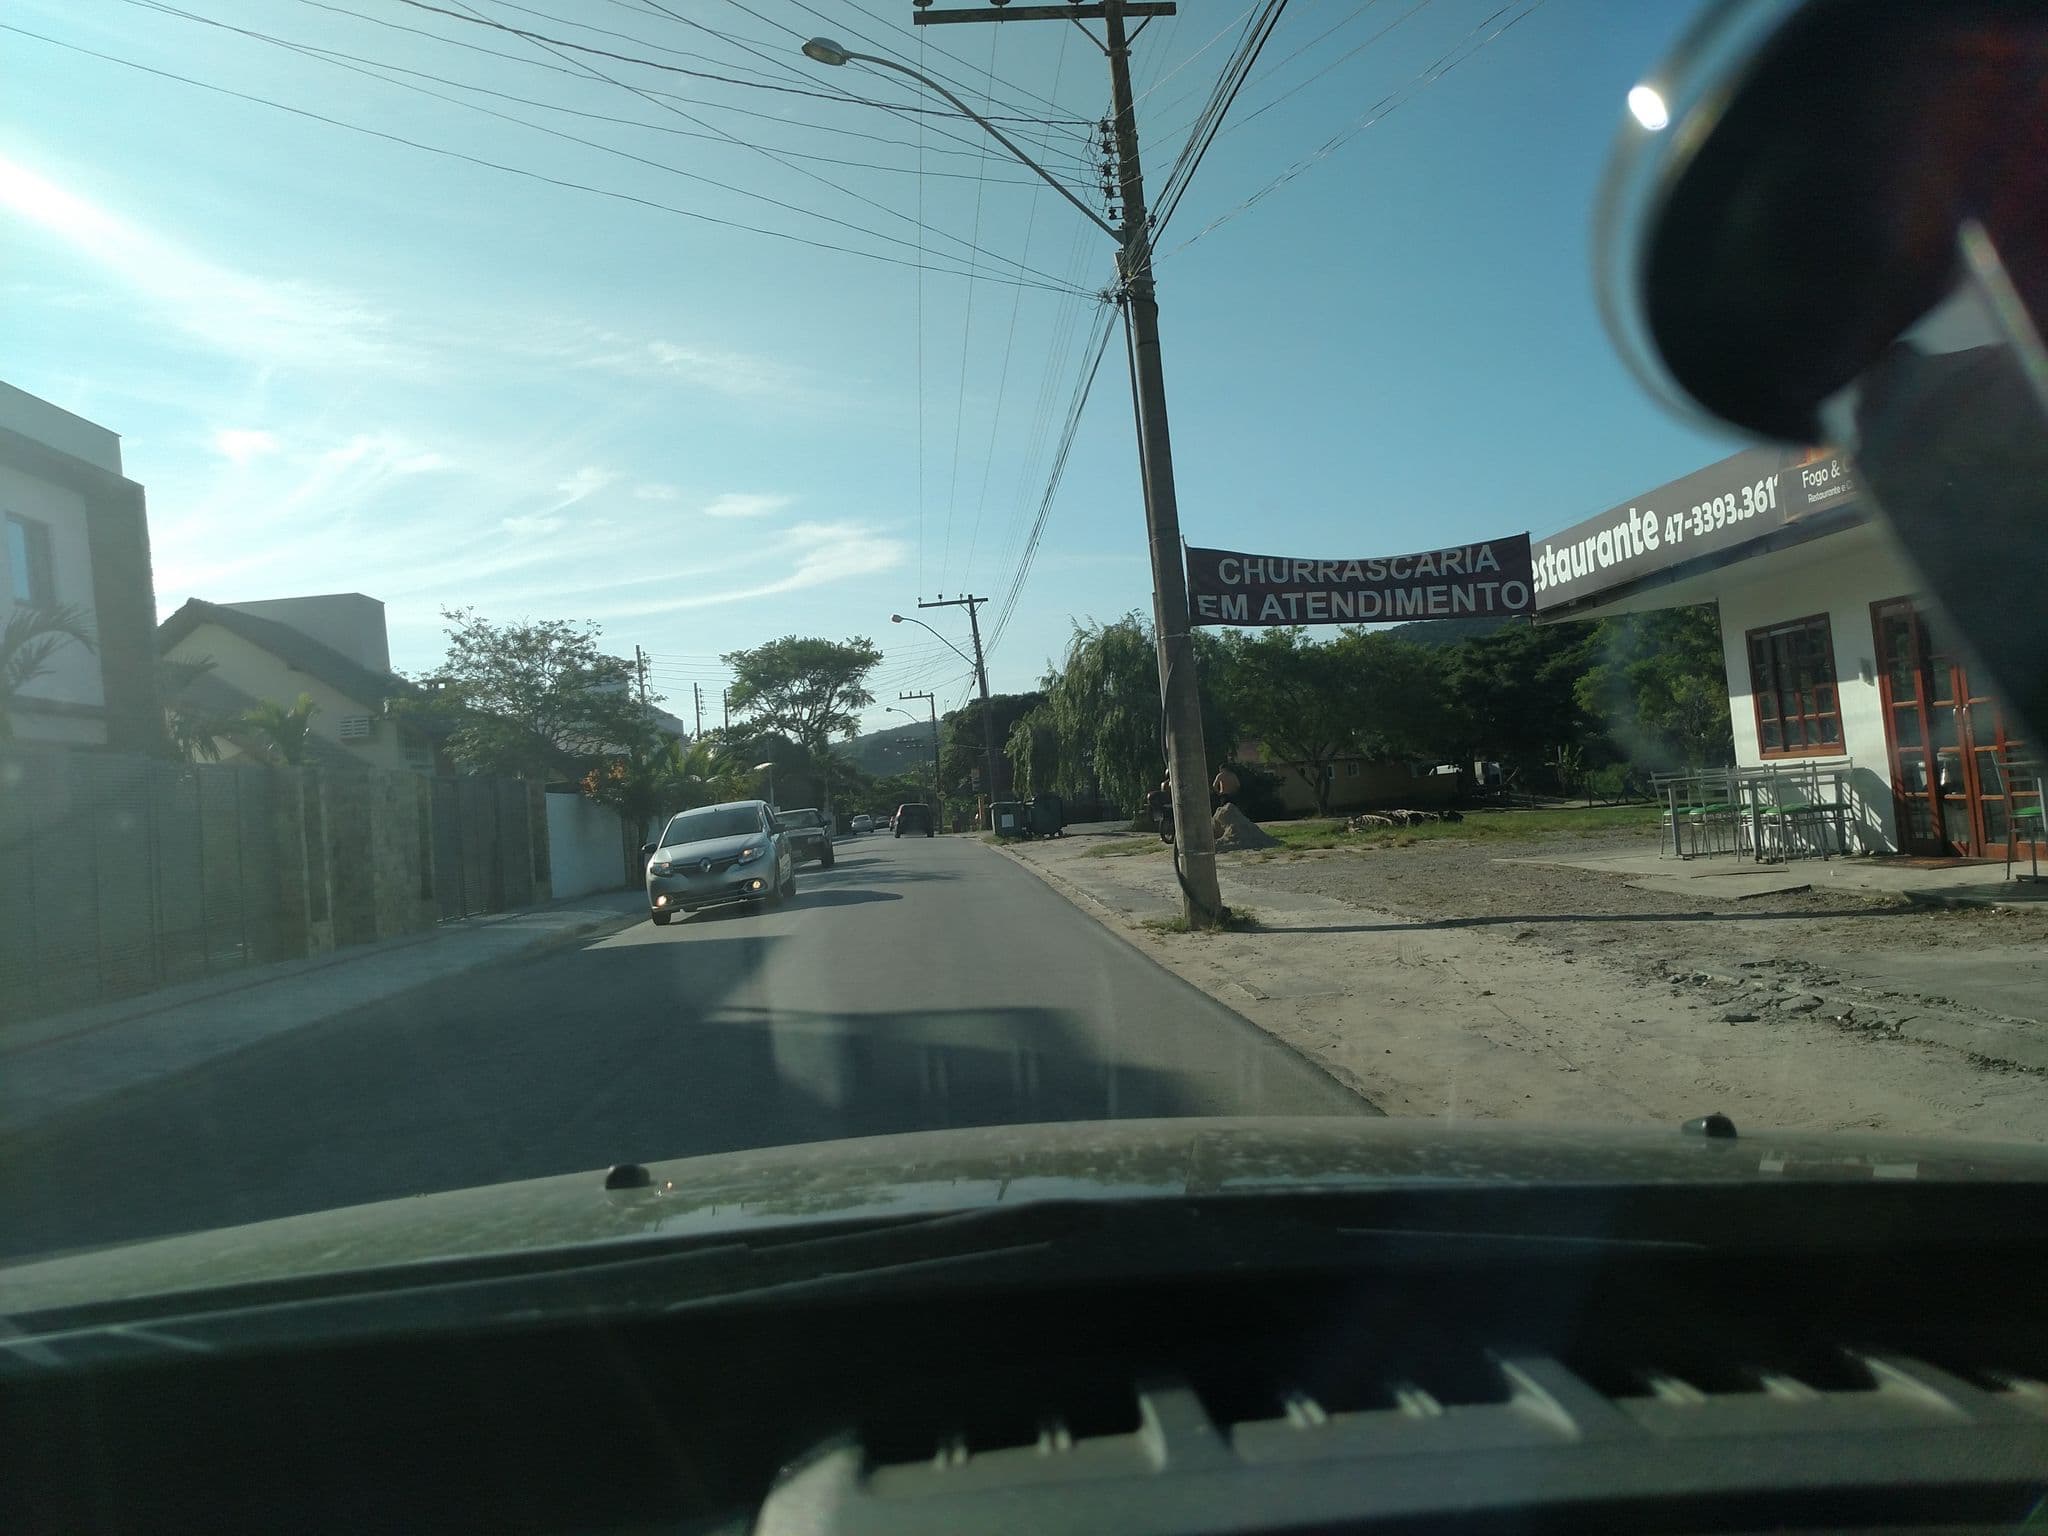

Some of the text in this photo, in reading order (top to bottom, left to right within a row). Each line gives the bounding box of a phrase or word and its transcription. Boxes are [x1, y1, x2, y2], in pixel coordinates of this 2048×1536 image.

[1802, 468, 1829, 489] Fogo
[1831, 460, 1840, 478] &
[1218, 544, 1500, 584] CHURRASCARIA
[1197, 580, 1529, 621] EM ATENDIMENTO
